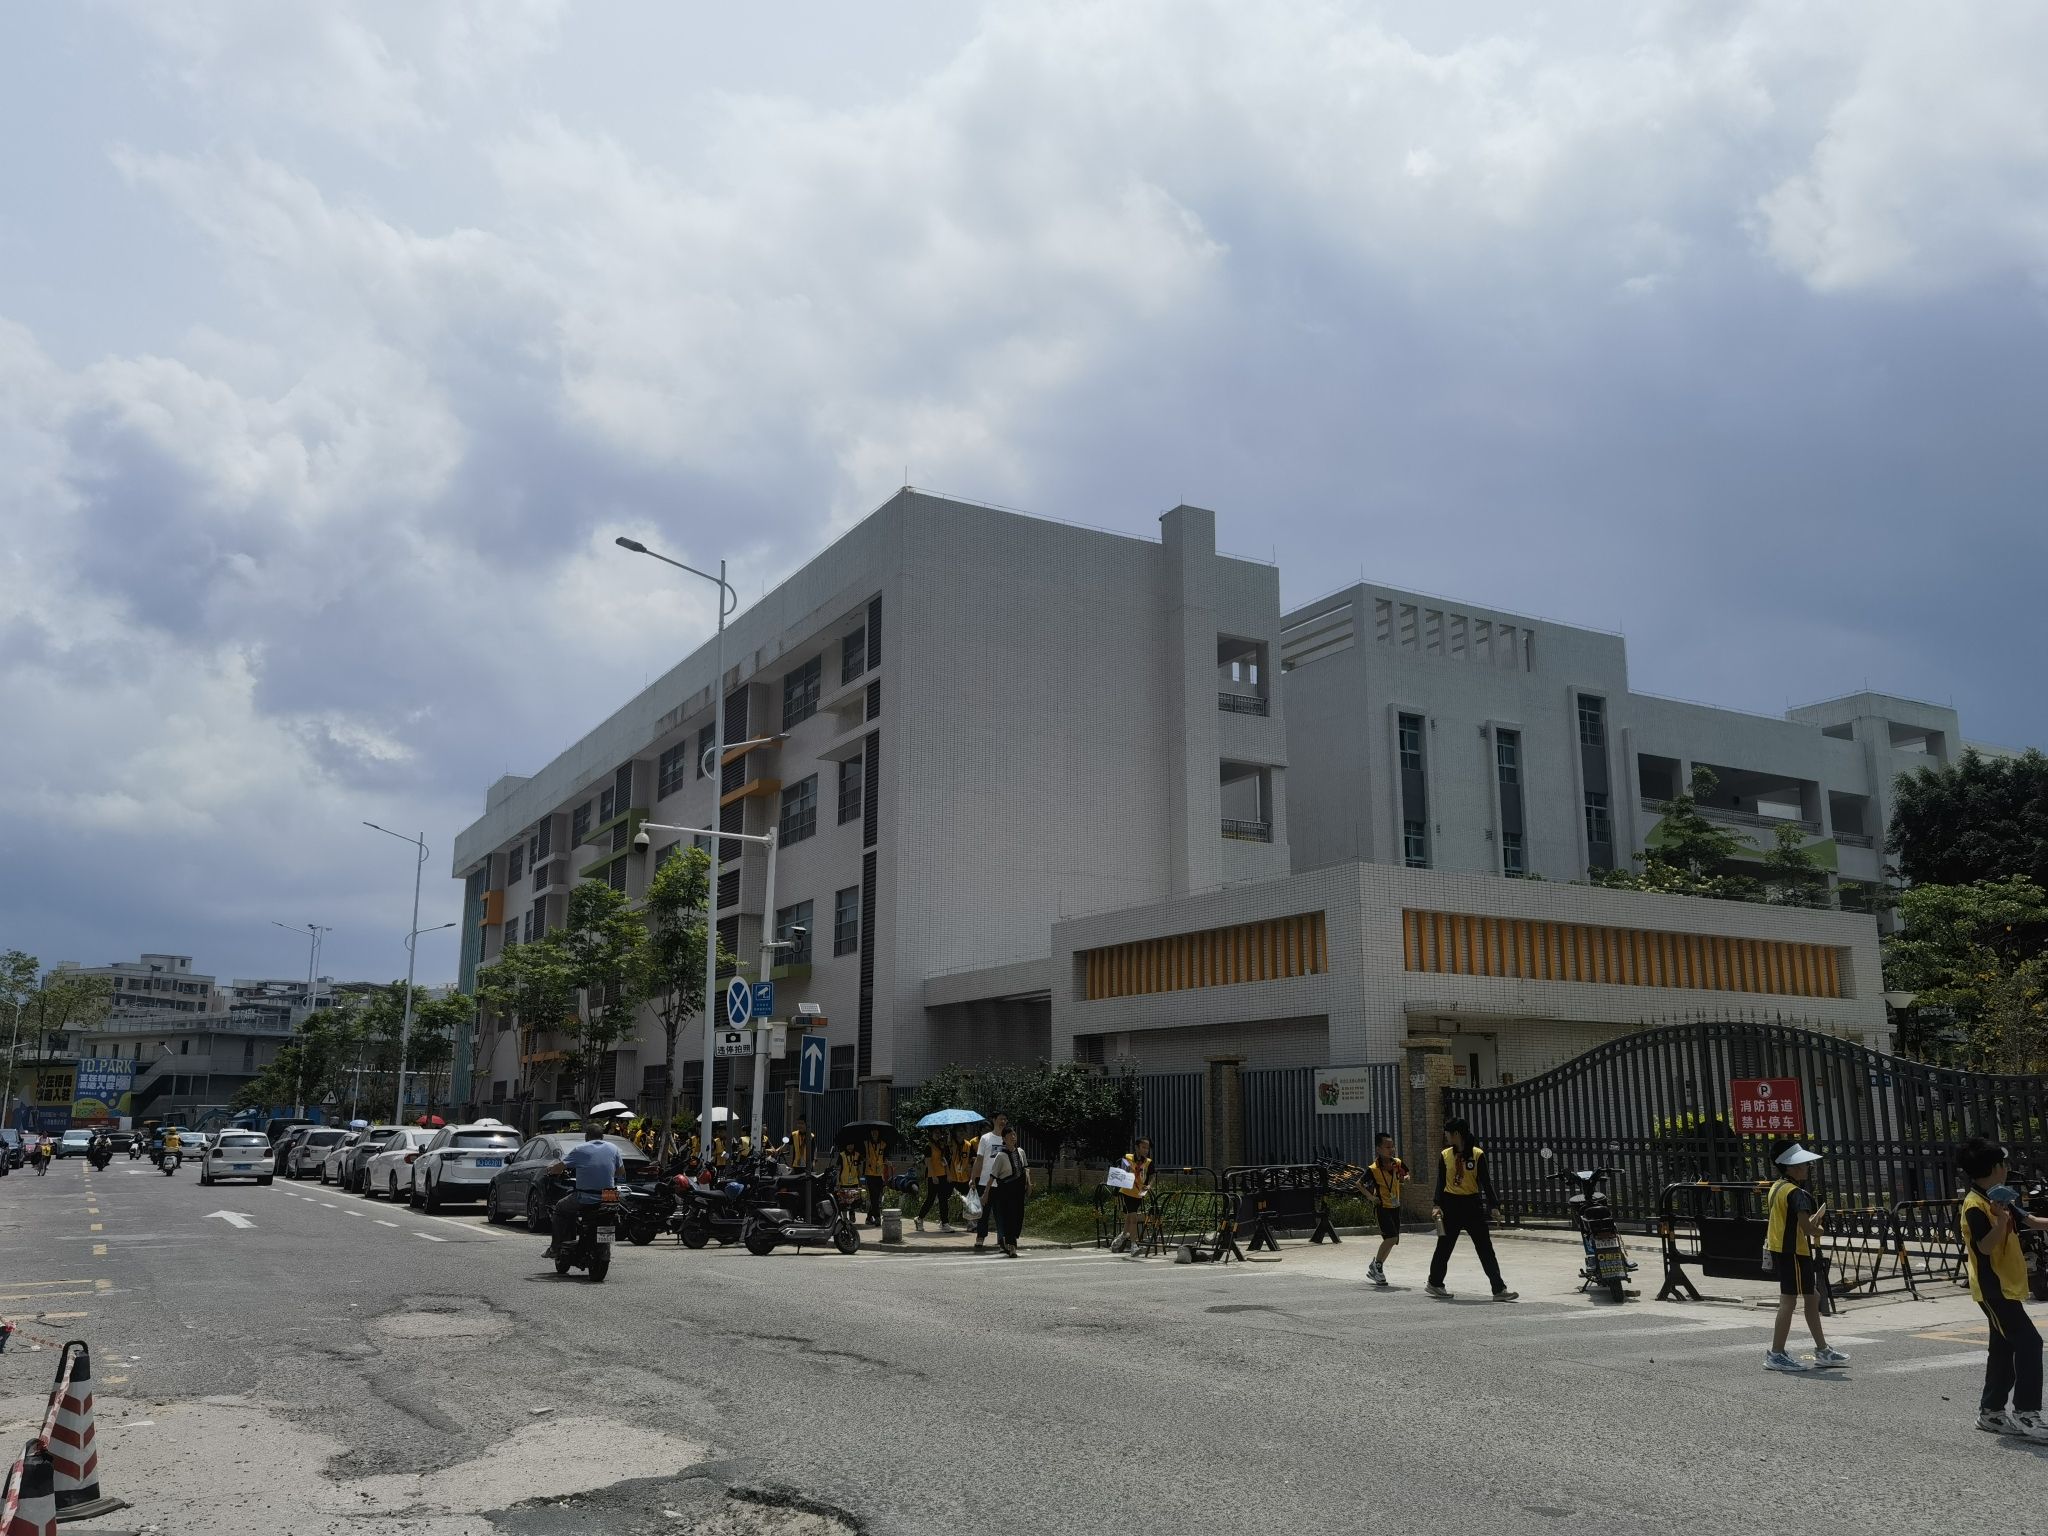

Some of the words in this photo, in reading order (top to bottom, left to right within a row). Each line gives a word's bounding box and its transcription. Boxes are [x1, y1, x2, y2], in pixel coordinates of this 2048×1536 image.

[717, 1044, 751, 1055] 违停拍照
[80, 1058, 132, 1074] TD.PARK
[1740, 1099, 1793, 1113] 消防通道
[1741, 1115, 1795, 1129] 禁止停车
